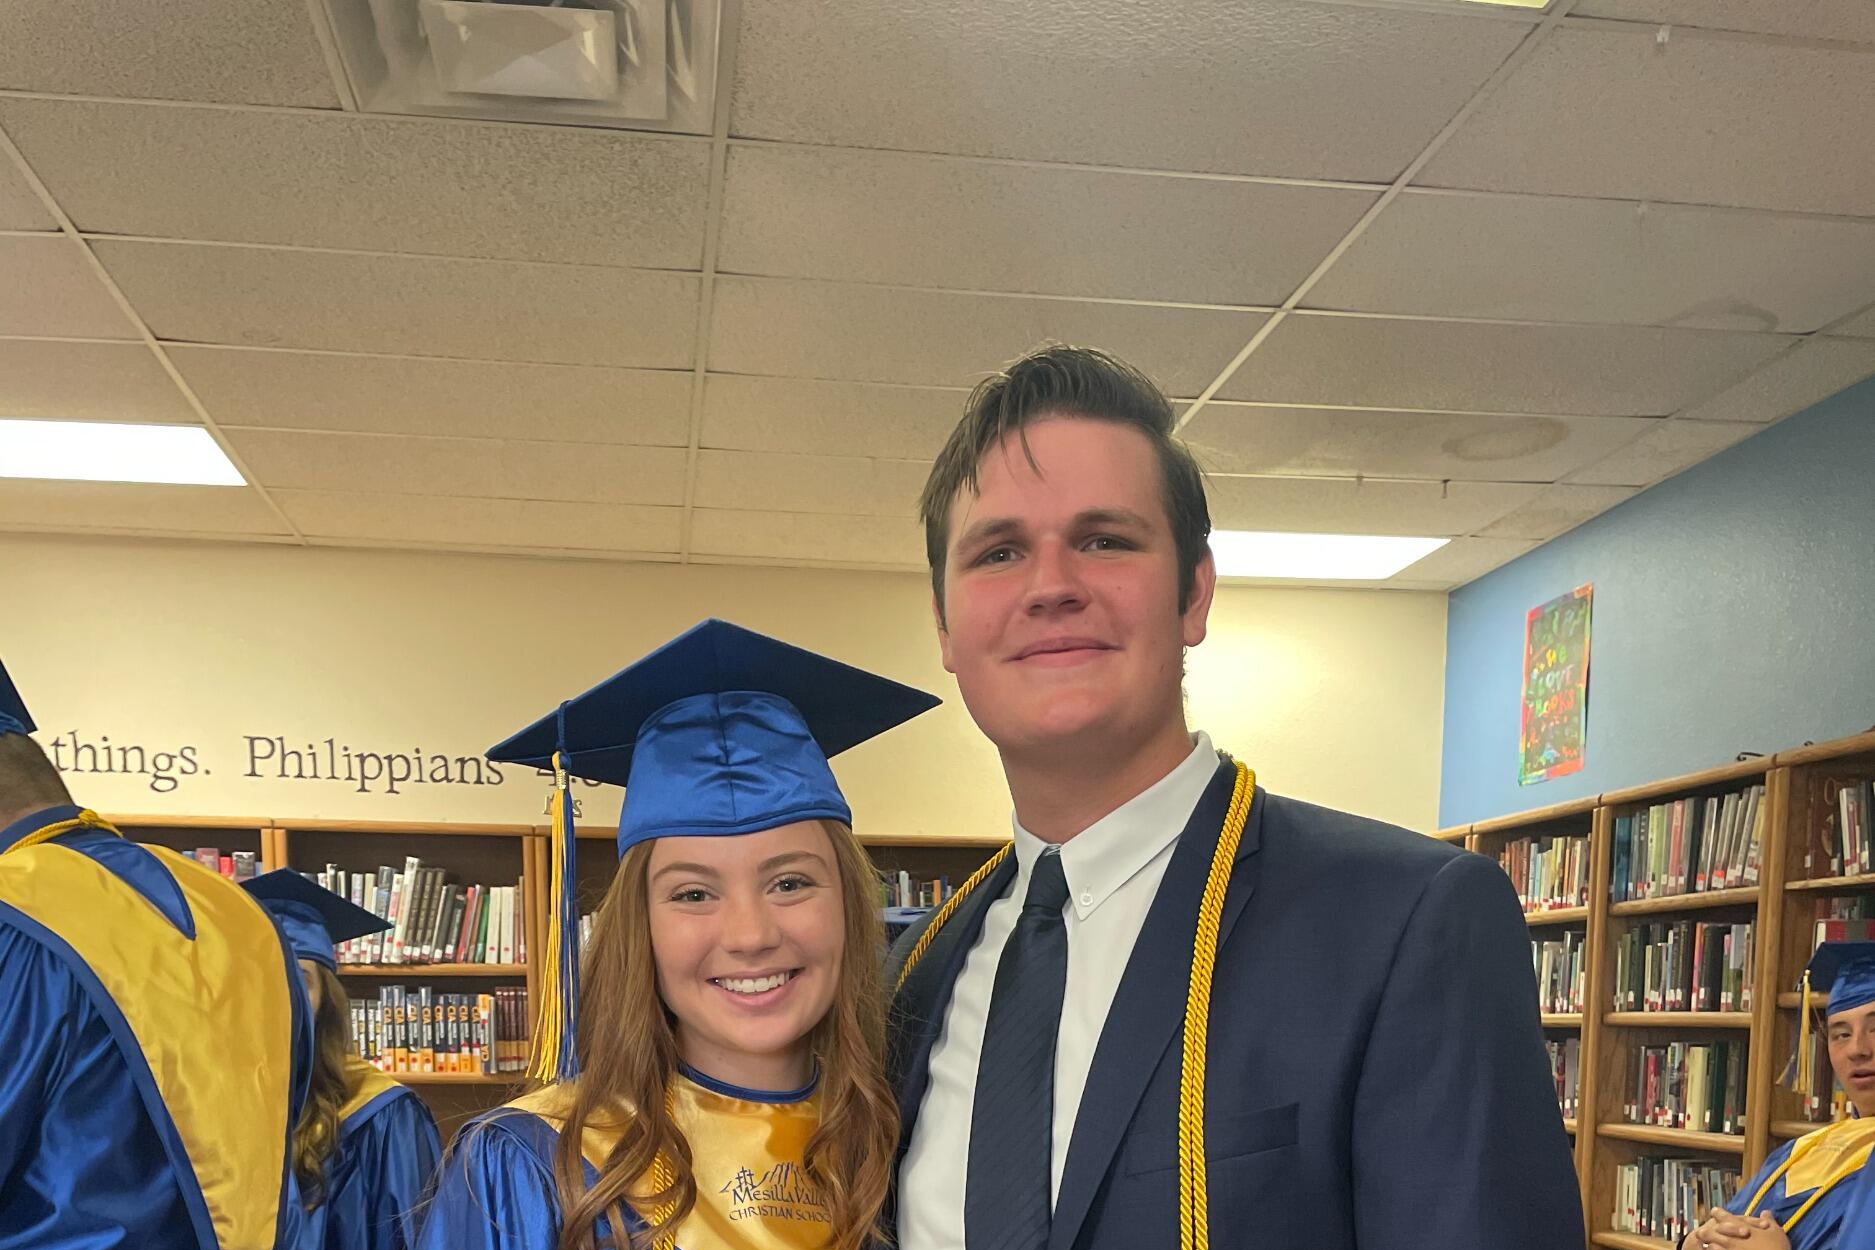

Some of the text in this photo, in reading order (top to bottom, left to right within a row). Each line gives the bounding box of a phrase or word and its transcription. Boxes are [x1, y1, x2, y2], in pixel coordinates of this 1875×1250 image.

[50, 729, 504, 794] things. Philippians
[732, 1184, 794, 1206] Mesilla
[729, 1205, 832, 1224] CHRISTIAN SCHOO
